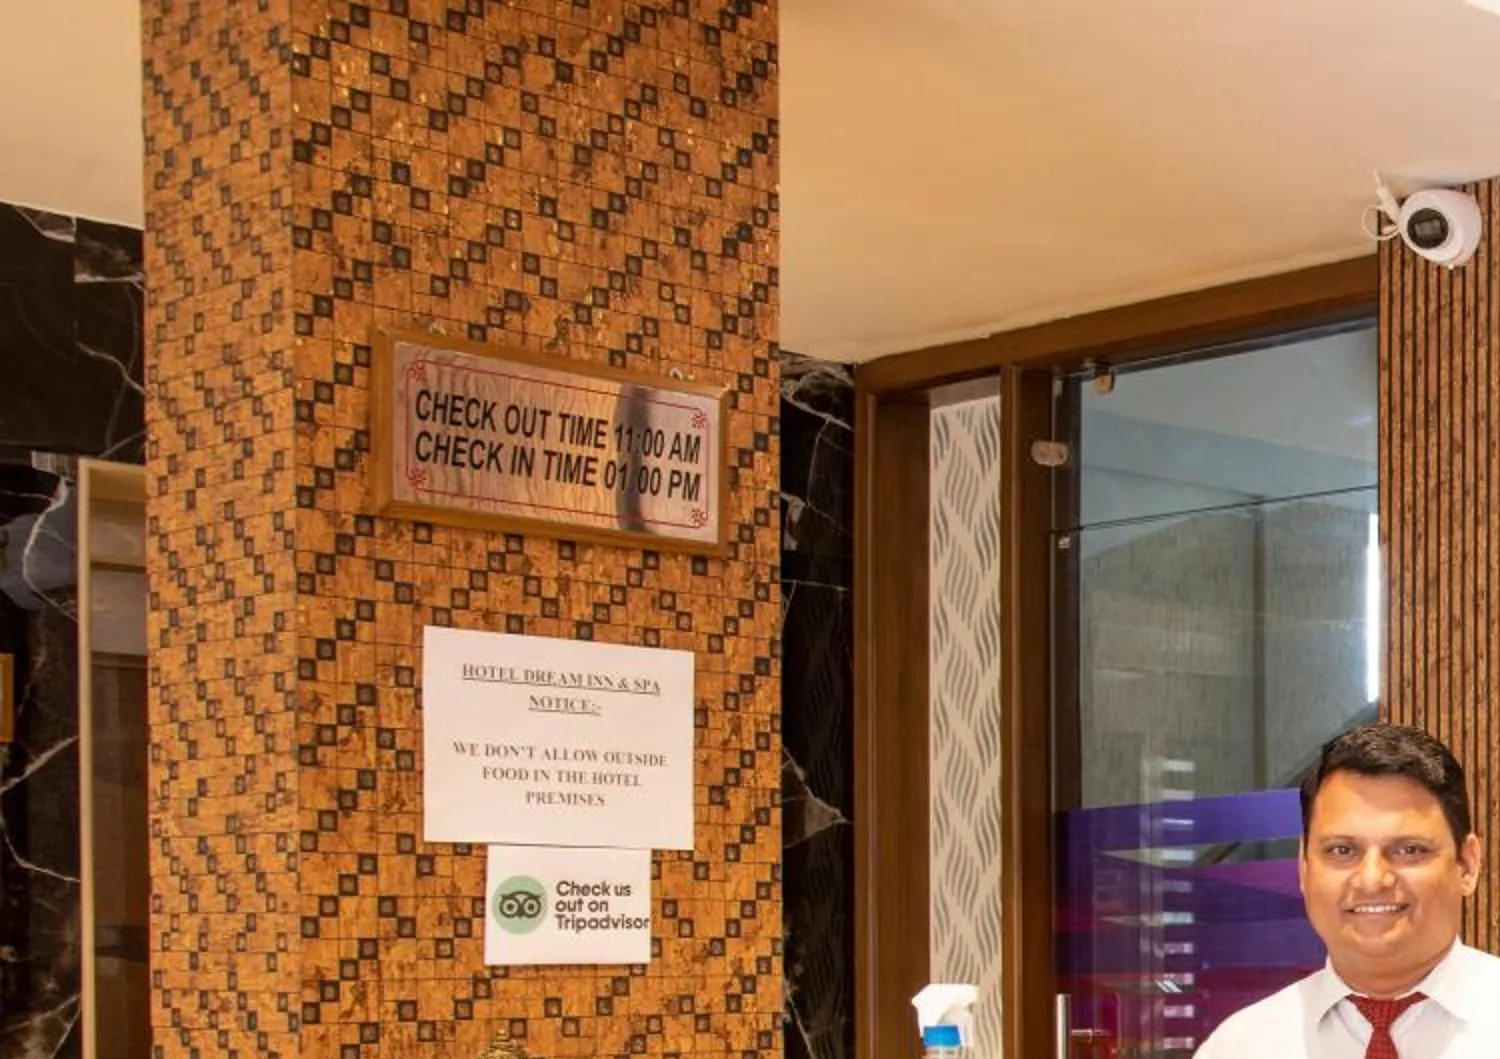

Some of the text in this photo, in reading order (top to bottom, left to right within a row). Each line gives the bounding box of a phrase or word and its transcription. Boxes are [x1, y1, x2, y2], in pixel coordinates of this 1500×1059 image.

[416, 389, 701, 464] CHECK OUT TIME 11:00 AM
[416, 431, 700, 501] CHECK IN TIME 0100 PM
[462, 663, 661, 693] HOTEL DREAM INN & SPA
[452, 741, 668, 767] WE DON'T ALLOW OUTSIDE
[482, 766, 643, 787] FOOD IN THE HOTEL
[525, 790, 606, 807] PREMISES
[556, 880, 631, 897] Check us
[555, 898, 608, 912] out on
[555, 914, 650, 934] Tripadvisor
